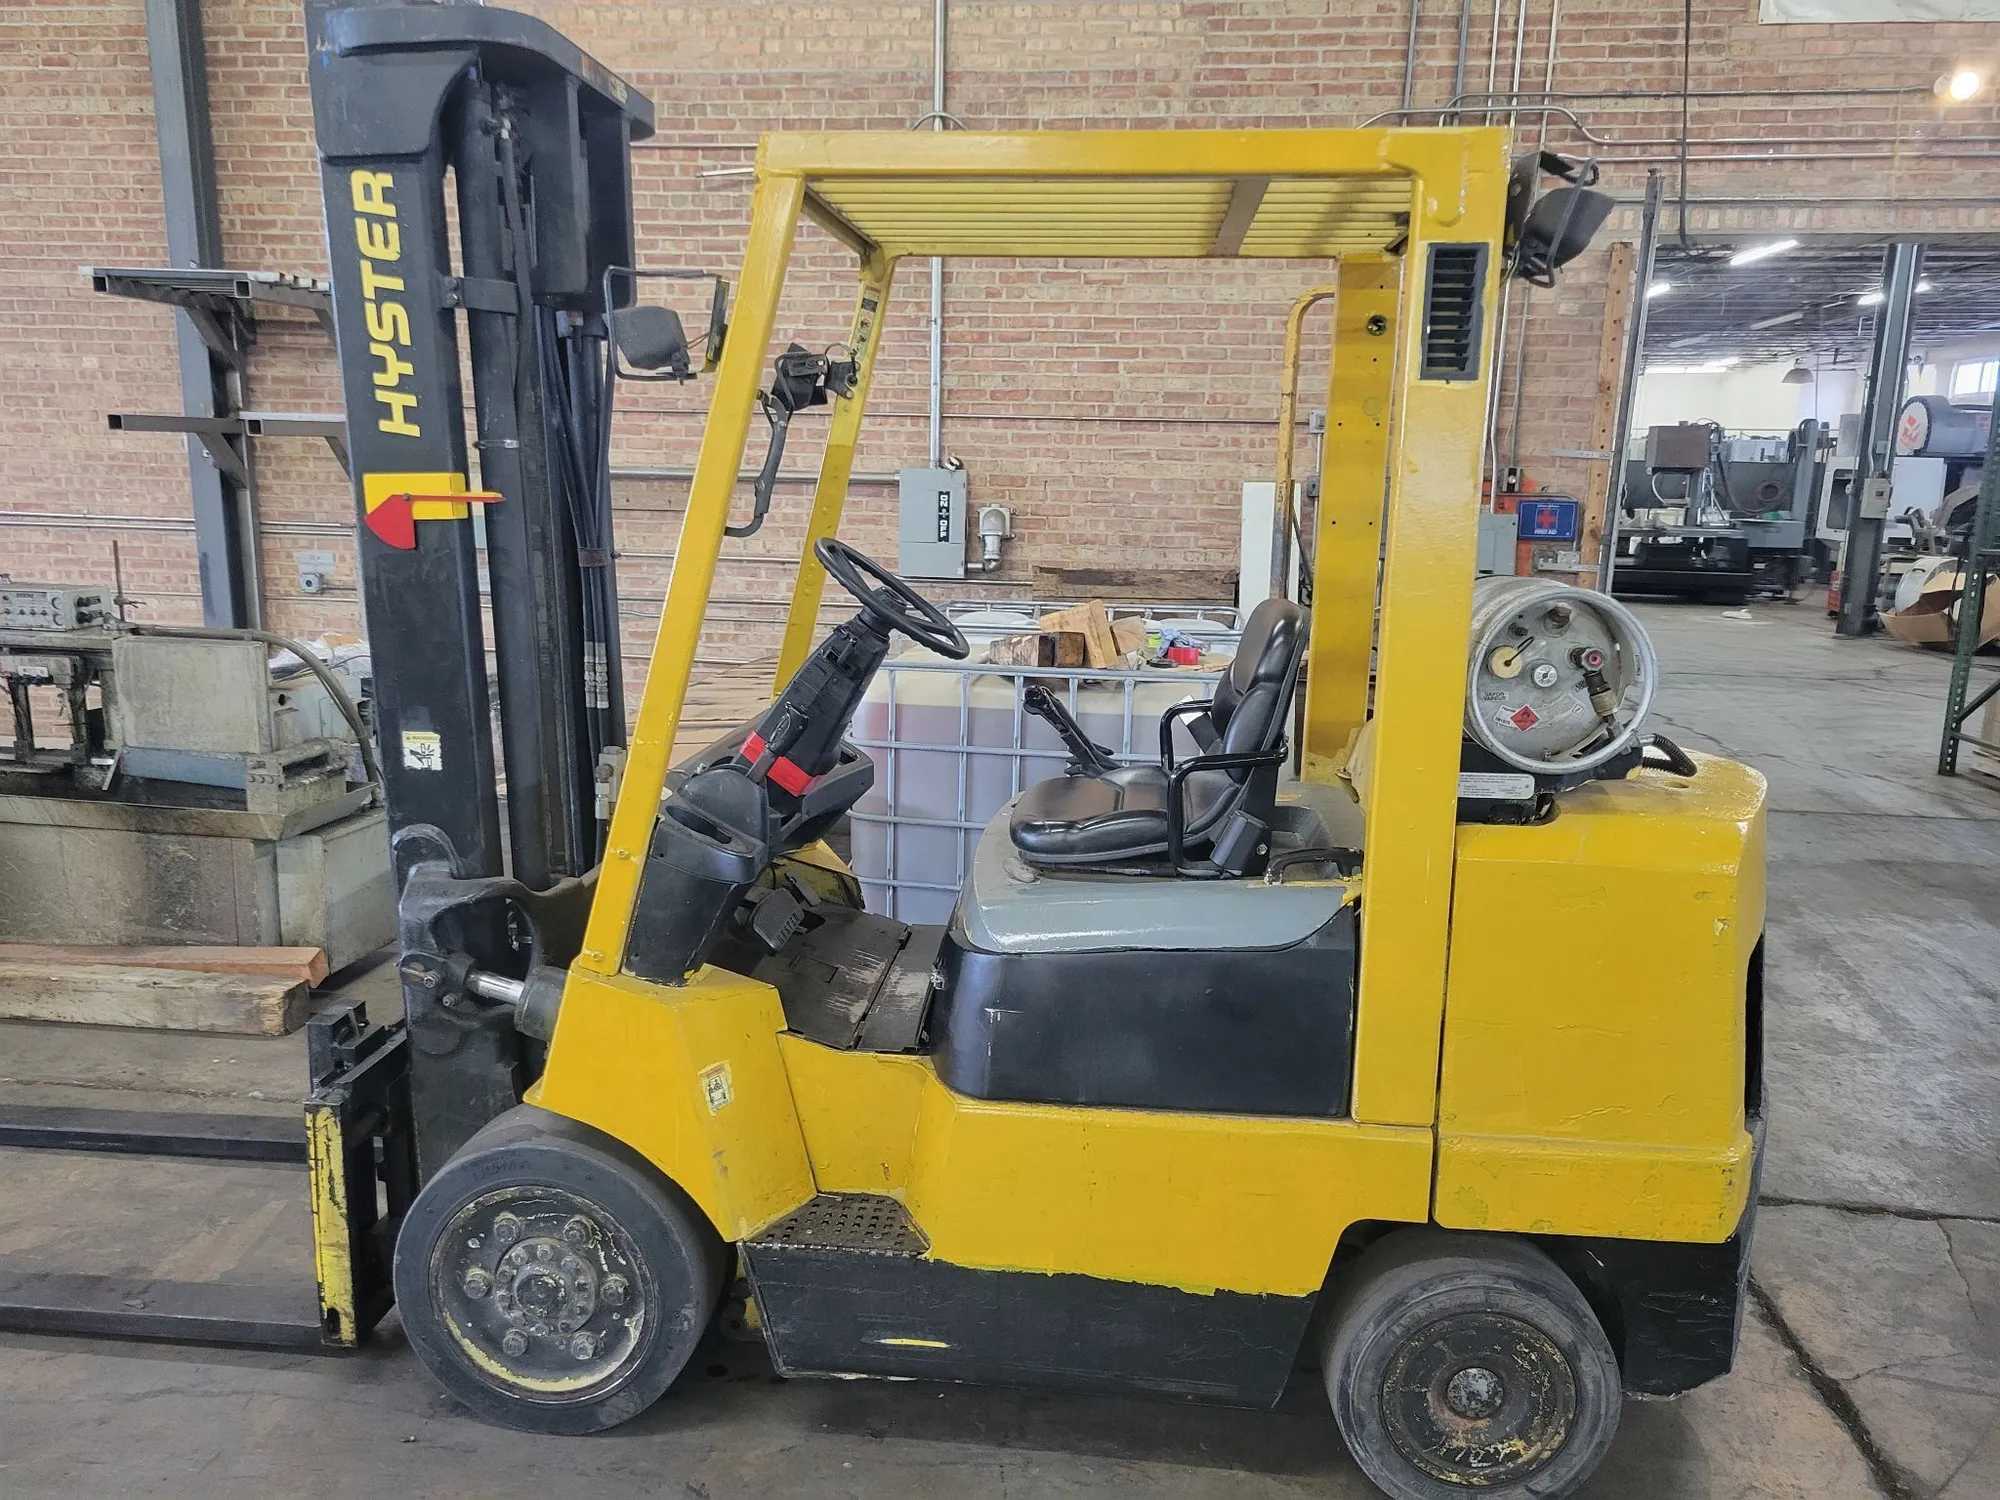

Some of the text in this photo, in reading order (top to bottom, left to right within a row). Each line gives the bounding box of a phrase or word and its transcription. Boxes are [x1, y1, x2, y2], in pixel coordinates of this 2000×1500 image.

[351, 169, 421, 437] HYSTER
[939, 494, 949, 538] ON OFF
